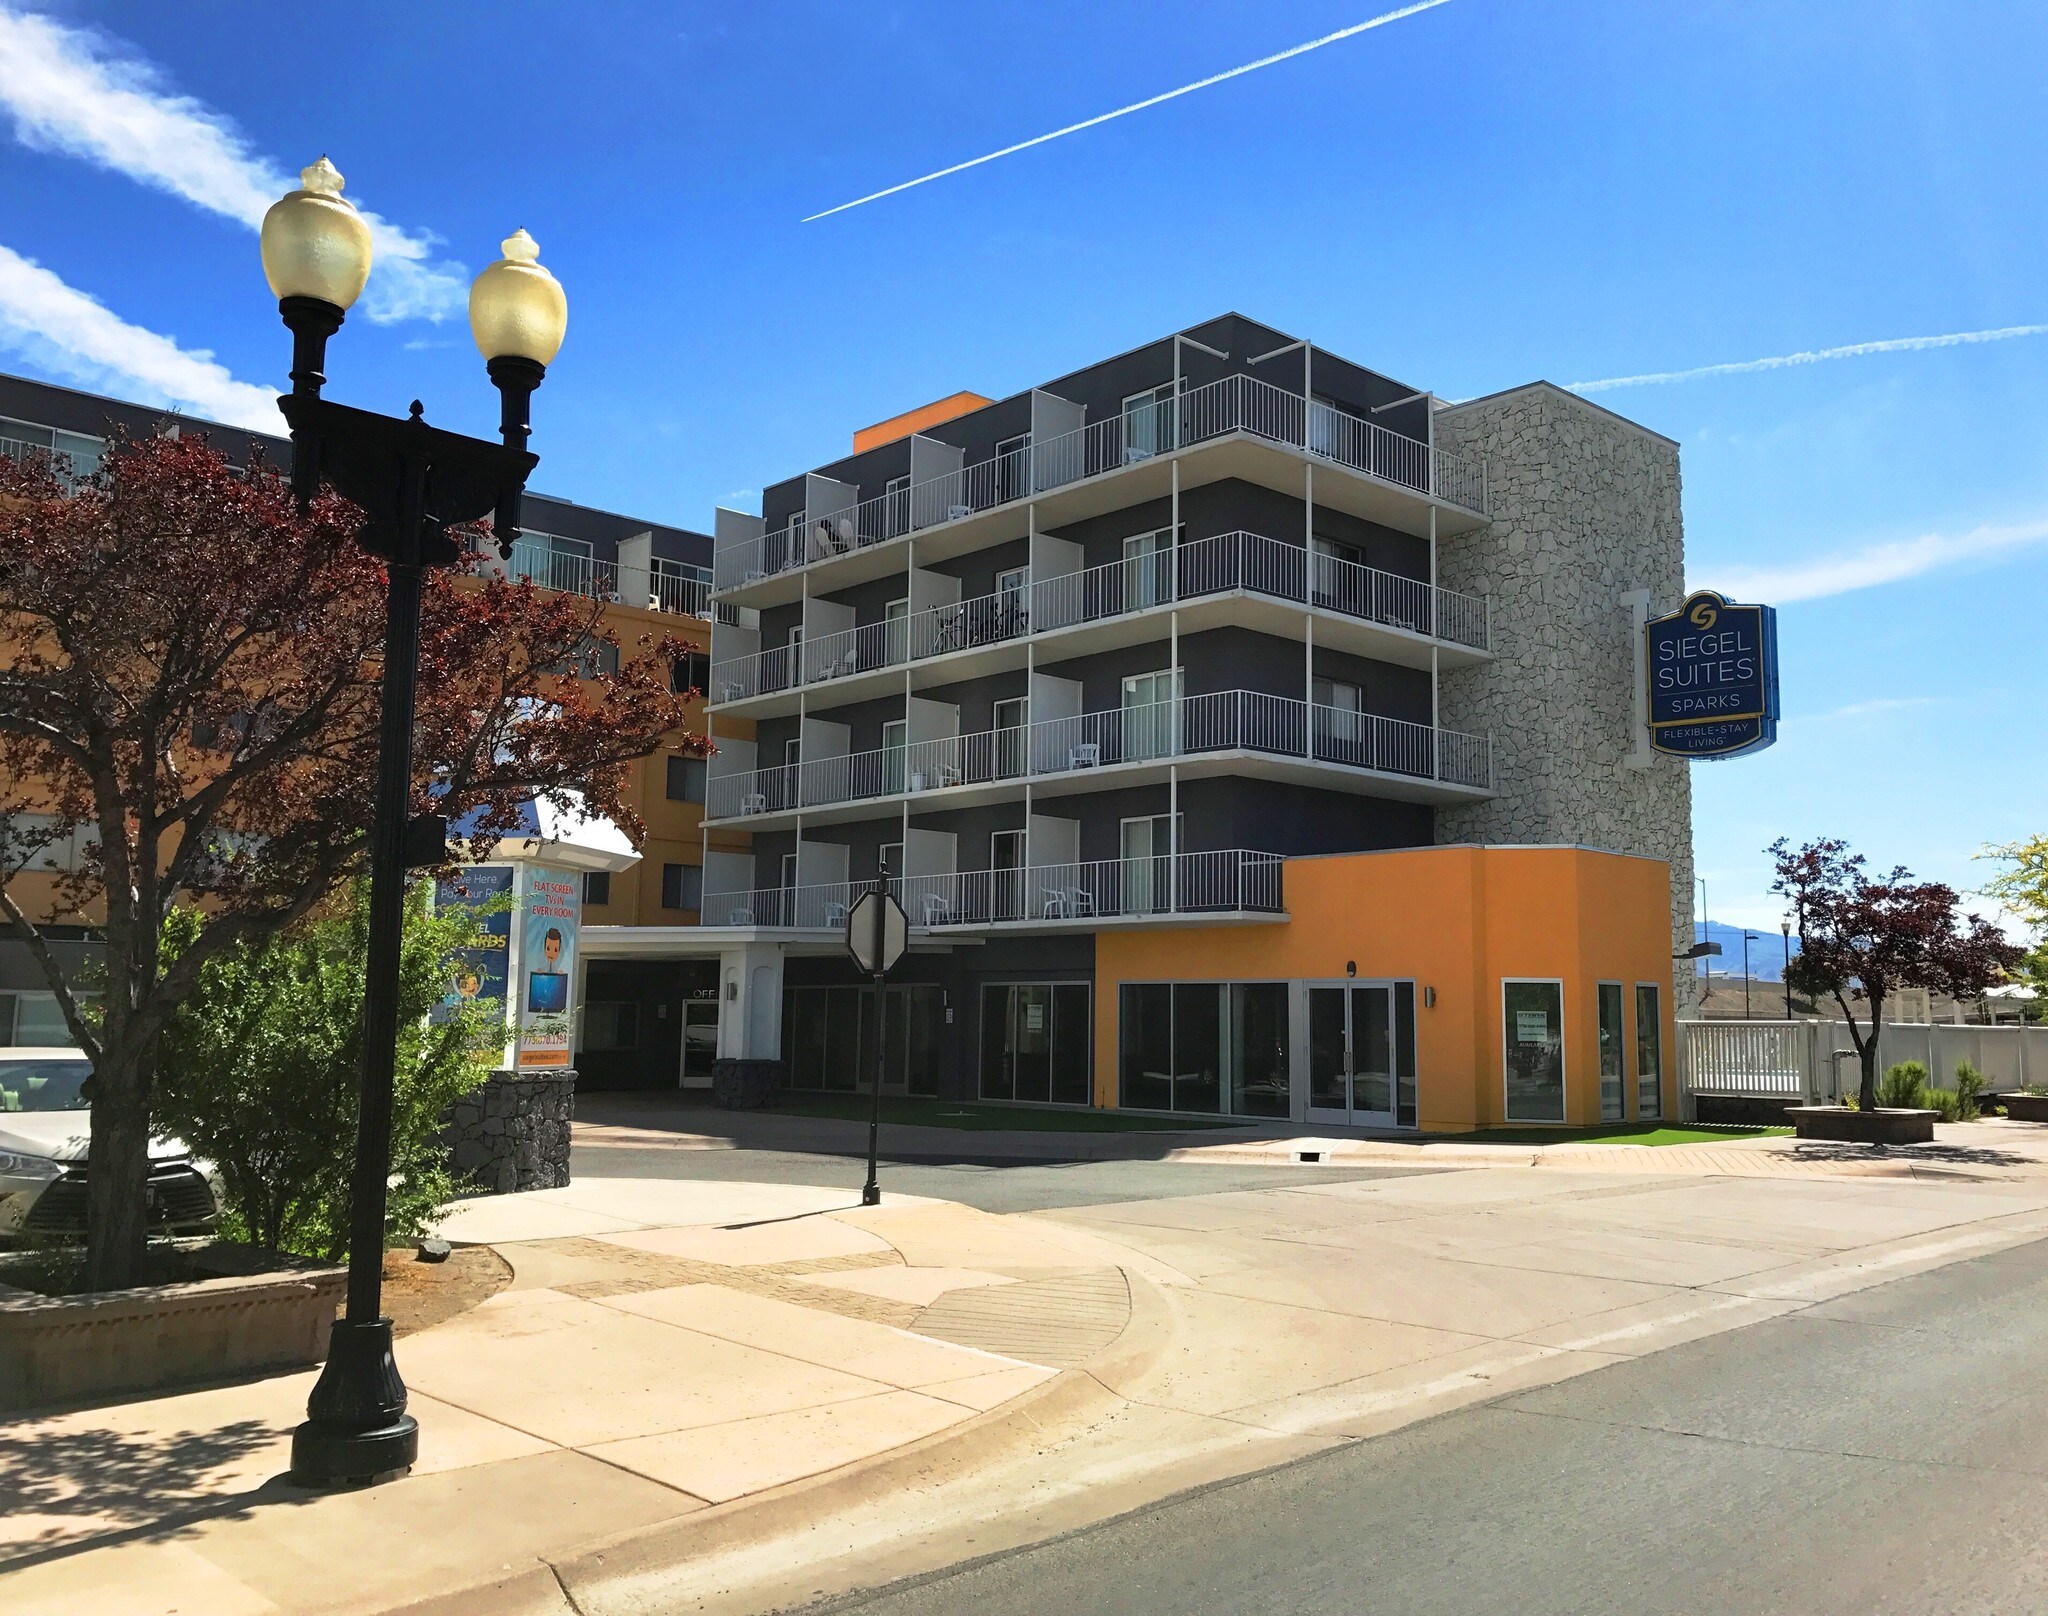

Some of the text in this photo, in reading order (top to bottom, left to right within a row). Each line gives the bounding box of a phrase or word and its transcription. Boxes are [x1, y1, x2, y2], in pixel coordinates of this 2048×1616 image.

[1659, 631, 1751, 661] SIEGEL
[1658, 658, 1754, 689] SUITES
[1672, 694, 1741, 713] SPARKS
[1664, 723, 1749, 739] FLEXIBLE-STAY
[1688, 737, 1724, 748] LIVING
[533, 881, 574, 895] FLAT SCREEN
[545, 894, 565, 906] TVs IN
[532, 905, 574, 918] EVERY ROOM
